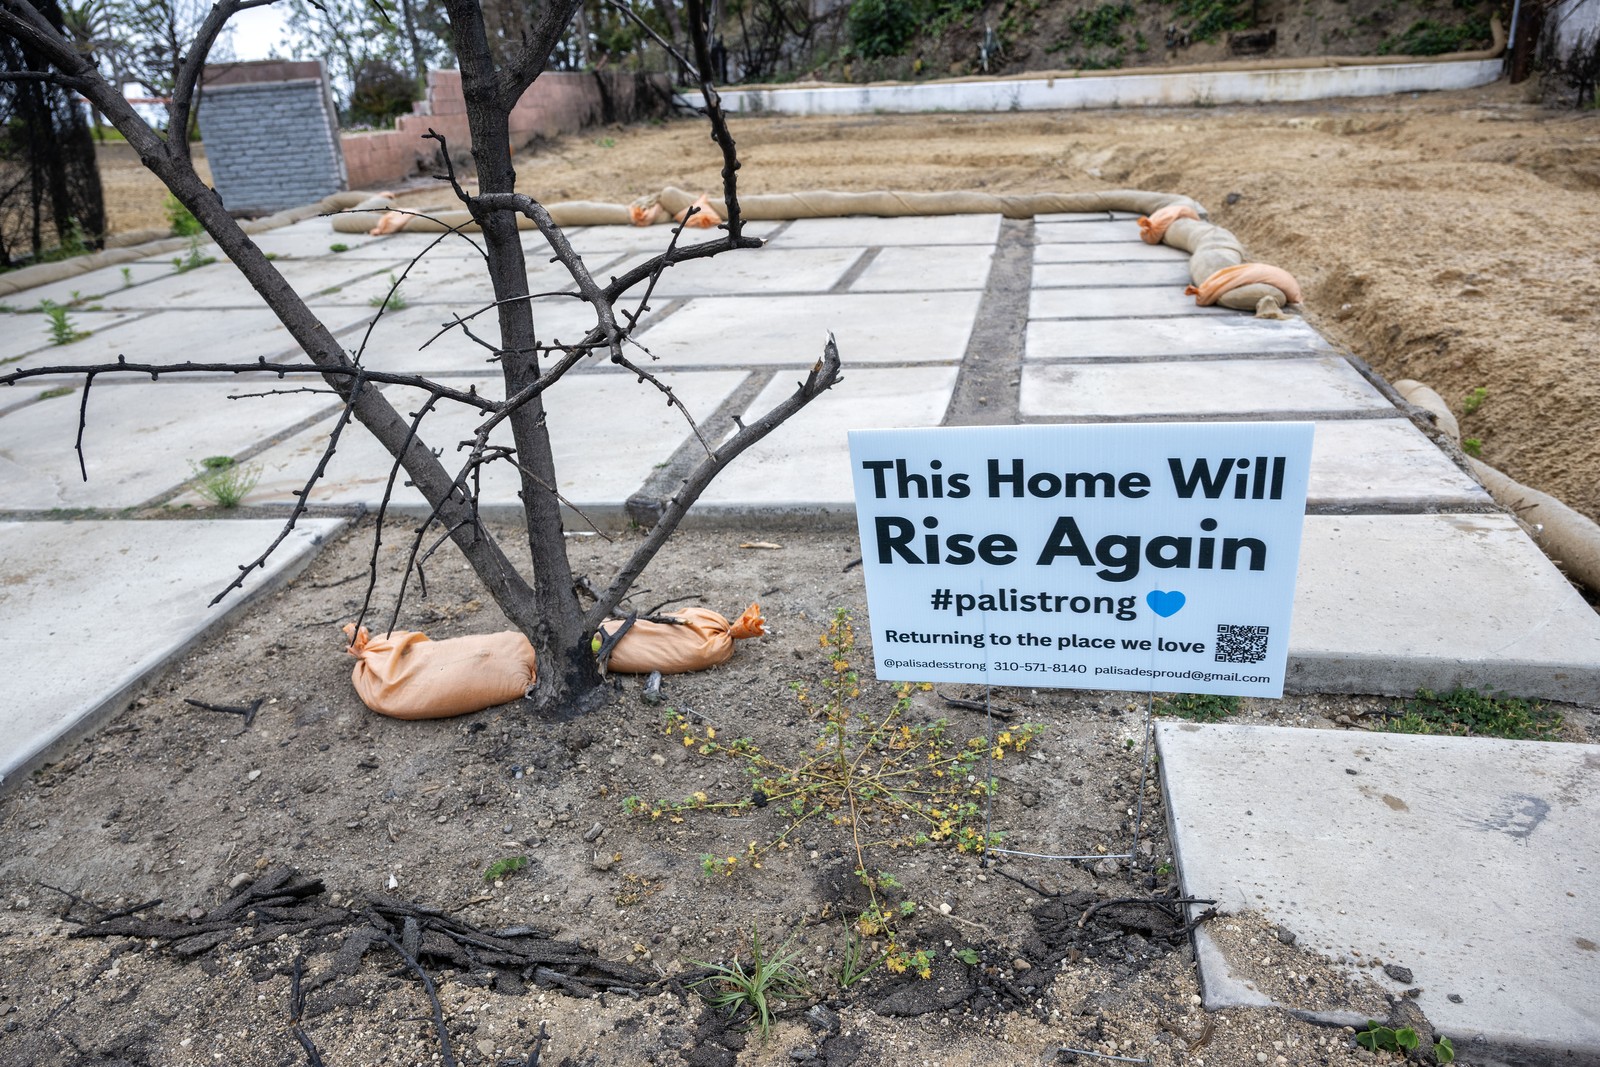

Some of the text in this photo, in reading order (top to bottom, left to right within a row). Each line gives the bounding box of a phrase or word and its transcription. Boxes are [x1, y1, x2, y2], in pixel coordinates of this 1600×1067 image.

[862, 457, 1286, 500] This Home Will
[875, 516, 1266, 582] Rise Again
[931, 589, 1137, 621] #palistrong
[886, 630, 1205, 653] Returning to the place we love
[884, 659, 1270, 683] @palisadesstrong 310-571-8140 palisadesproud@gmail.com
